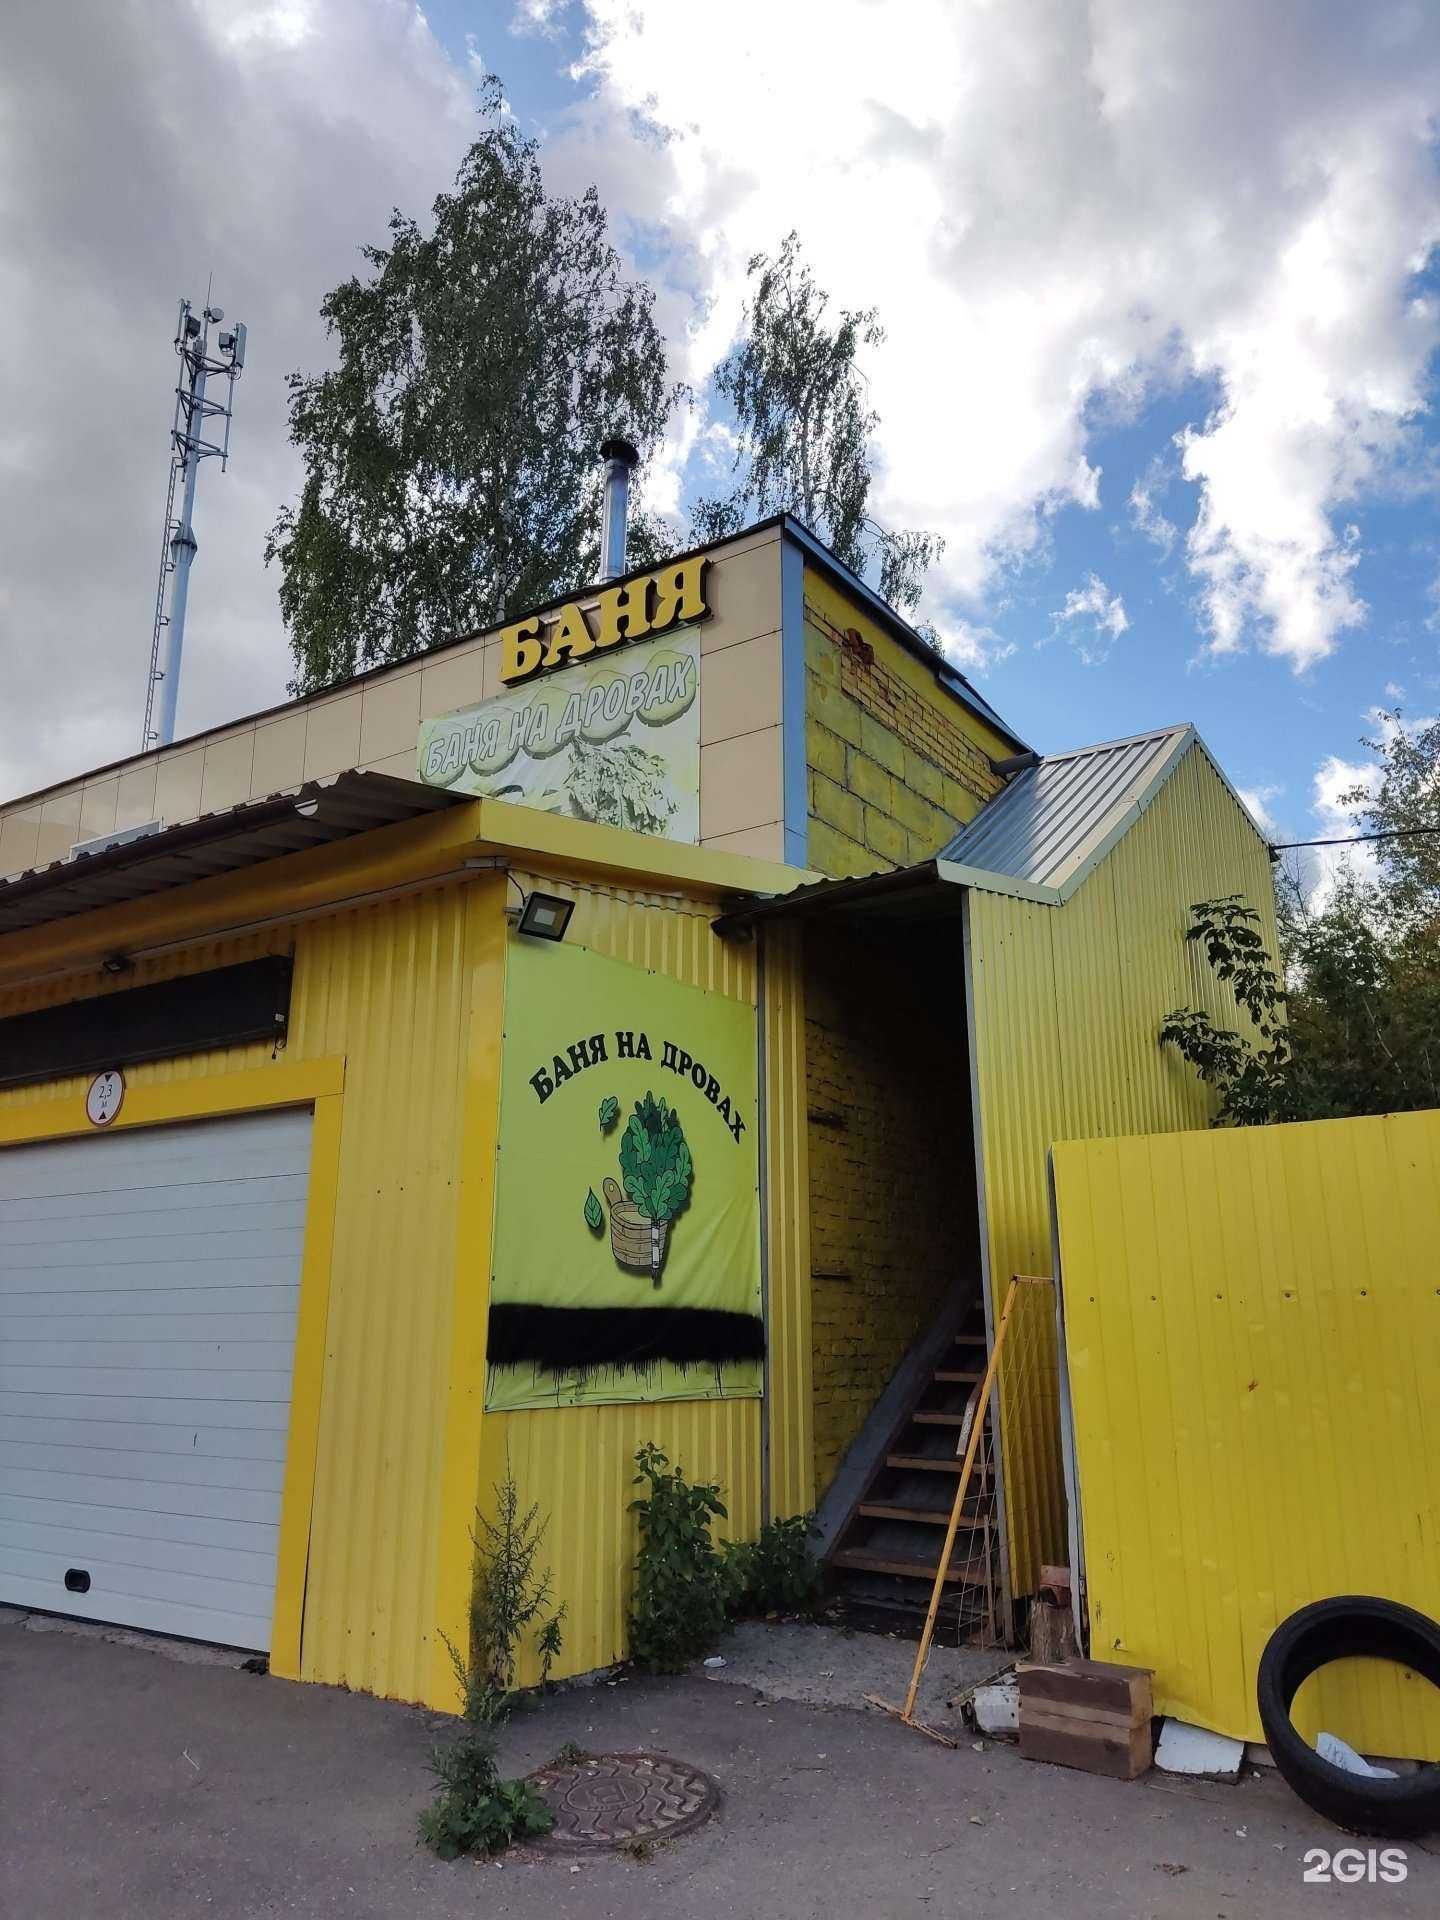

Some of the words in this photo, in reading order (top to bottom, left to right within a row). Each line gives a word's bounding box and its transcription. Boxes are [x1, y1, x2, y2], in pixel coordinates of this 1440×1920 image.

[500, 556, 708, 684] БАНЯ
[425, 719, 501, 778] БАНЯ
[508, 703, 549, 751] НА
[555, 655, 694, 745] ДРОВАХ
[99, 1084, 113, 1100] 2,3
[529, 1033, 608, 1105] БАНЯ
[615, 1031, 652, 1060] НА
[660, 1040, 746, 1144] ДРОВАХ
